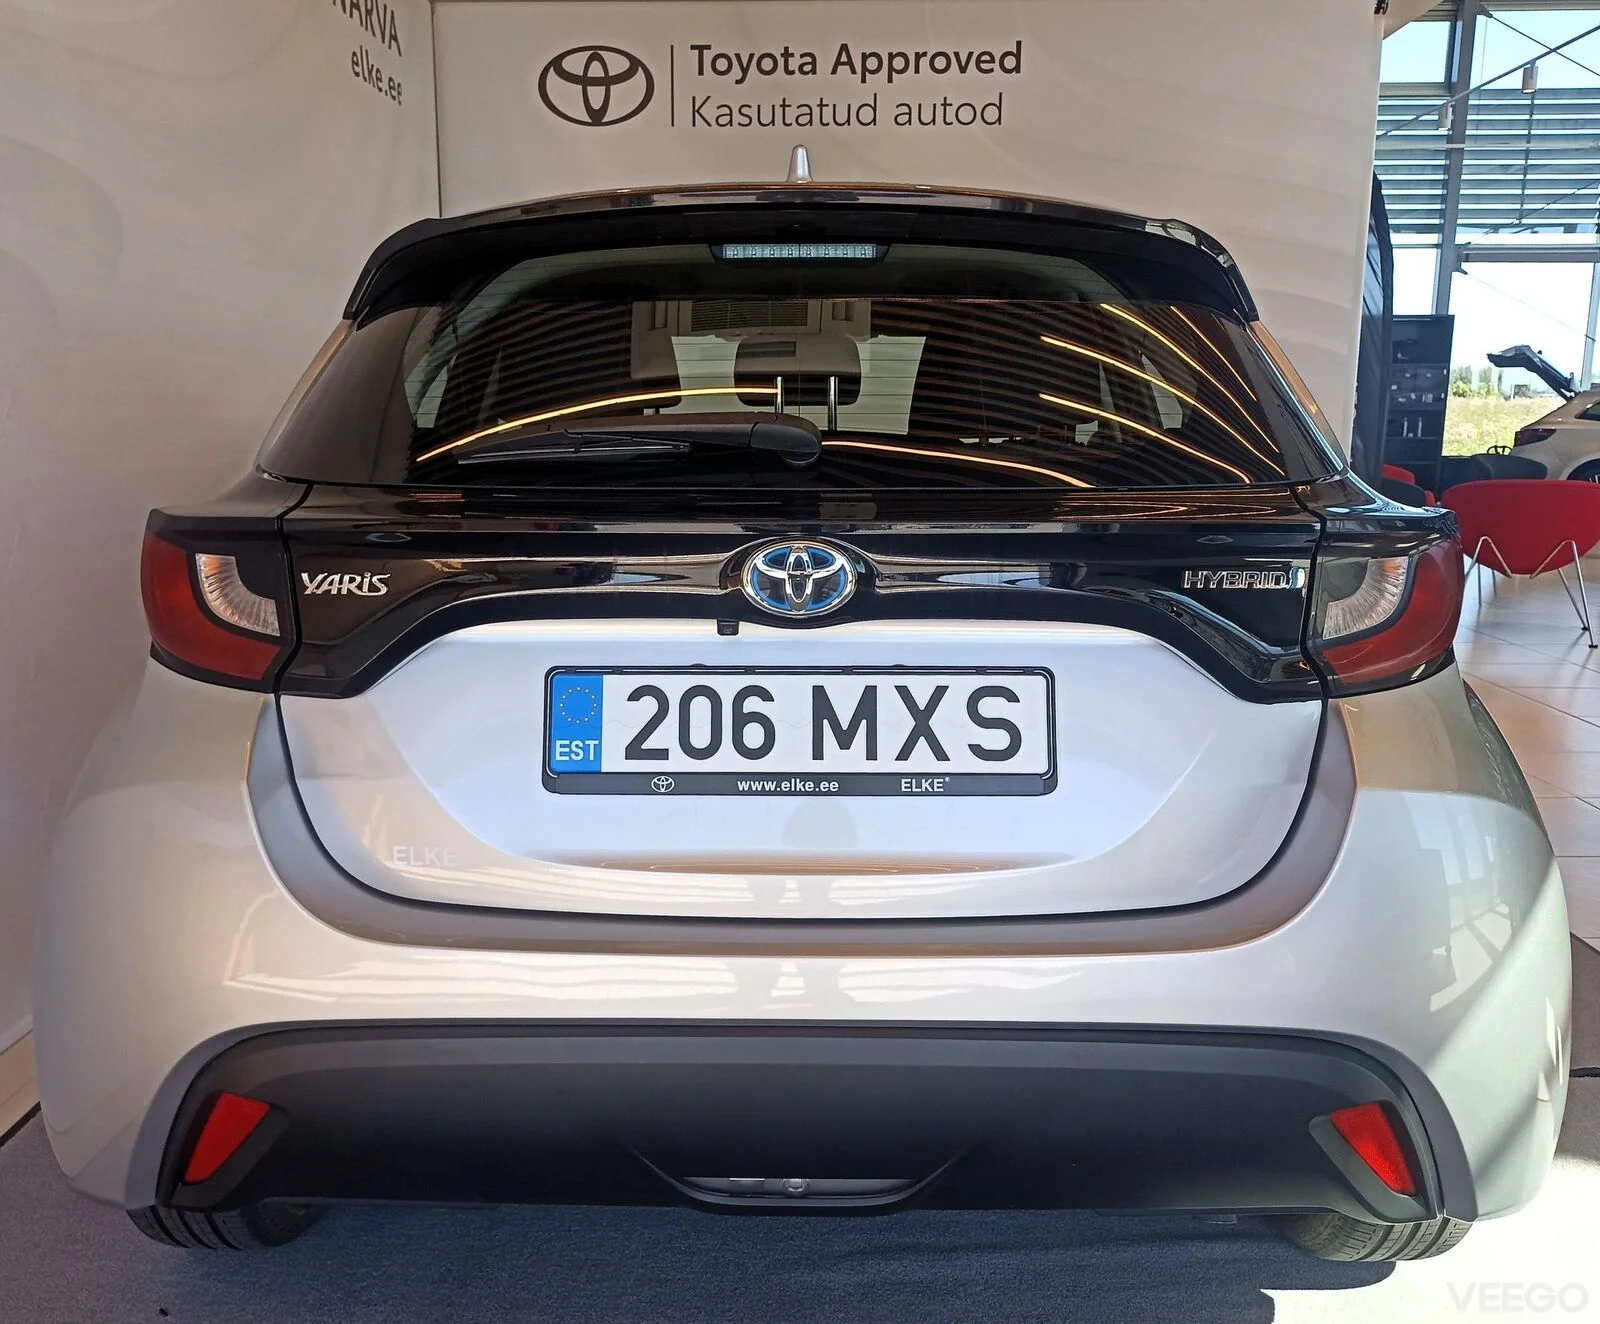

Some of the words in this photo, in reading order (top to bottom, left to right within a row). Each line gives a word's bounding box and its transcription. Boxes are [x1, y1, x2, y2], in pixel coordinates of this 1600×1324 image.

[690, 44, 818, 85] Toyota
[830, 40, 1022, 84] Approved
[690, 93, 878, 127] Kasutatud
[894, 92, 1003, 126] autod
[1183, 570, 1287, 589] HYBRID
[624, 685, 776, 761] 206
[812, 685, 1022, 761] MXS
[555, 740, 599, 761] EST
[737, 778, 839, 792] www.elke.ee
[392, 845, 458, 868] ELKE
